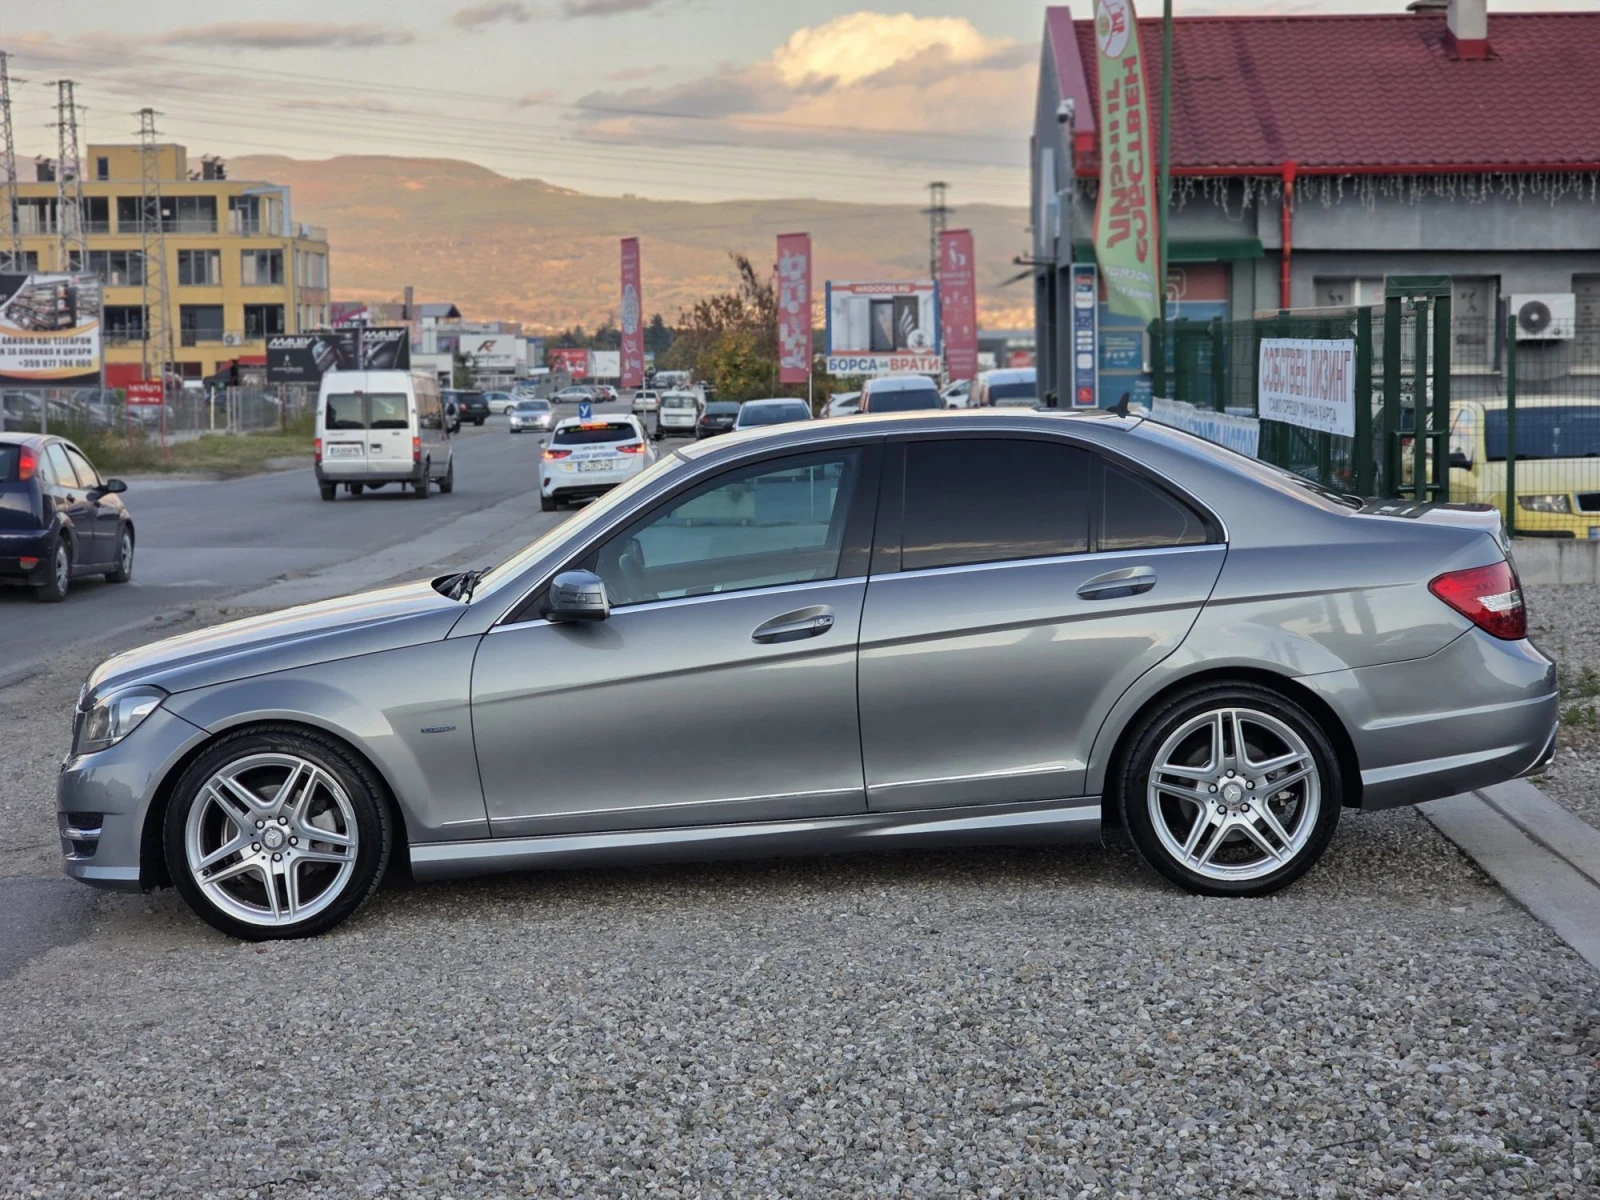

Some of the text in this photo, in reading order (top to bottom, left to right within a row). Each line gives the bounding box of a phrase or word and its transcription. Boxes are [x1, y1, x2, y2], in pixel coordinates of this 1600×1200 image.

[829, 358, 877, 371] БОРСА
[890, 357, 939, 371] ВРАТИ
[1263, 347, 1351, 402] СОБСТВЕН ЛИЗИНГ
[580, 405, 589, 416] У
